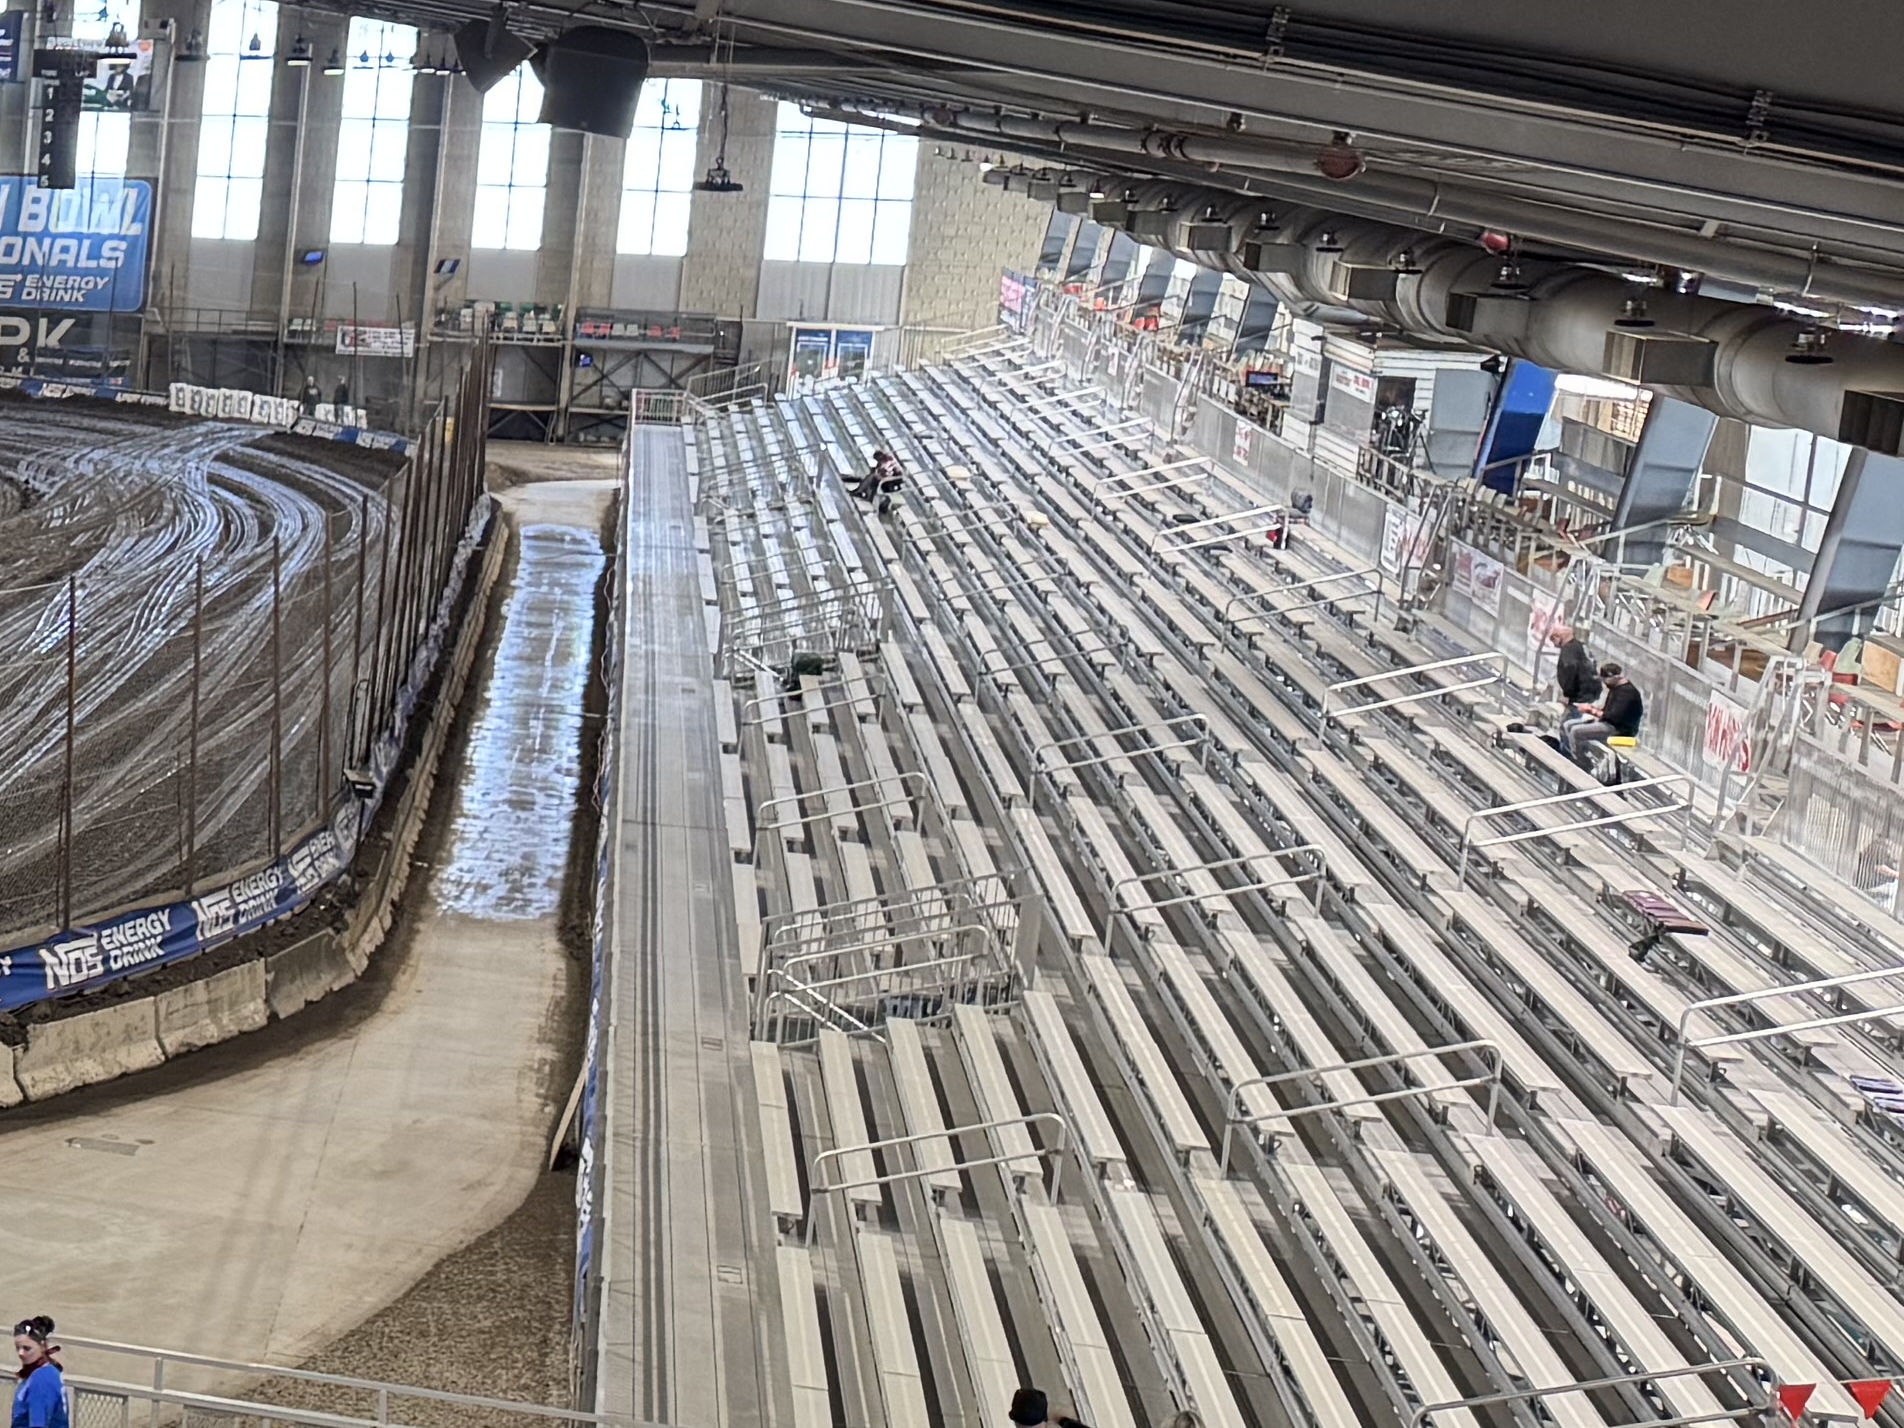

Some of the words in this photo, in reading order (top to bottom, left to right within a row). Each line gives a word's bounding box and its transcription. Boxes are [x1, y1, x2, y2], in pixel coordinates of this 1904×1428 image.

[46, 87, 54, 100] 1
[44, 109, 55, 122] 2
[42, 131, 53, 143] 3
[41, 153, 51, 165] 4
[40, 175, 49, 188] 5
[16, 187, 144, 236] BOWL
[24, 275, 110, 291] ENERGY
[20, 287, 87, 303] DRINK
[231, 866, 286, 902] ENERGY
[38, 930, 105, 990] NOS
[100, 908, 172, 950] ENERGY
[109, 935, 166, 971] DRINK
